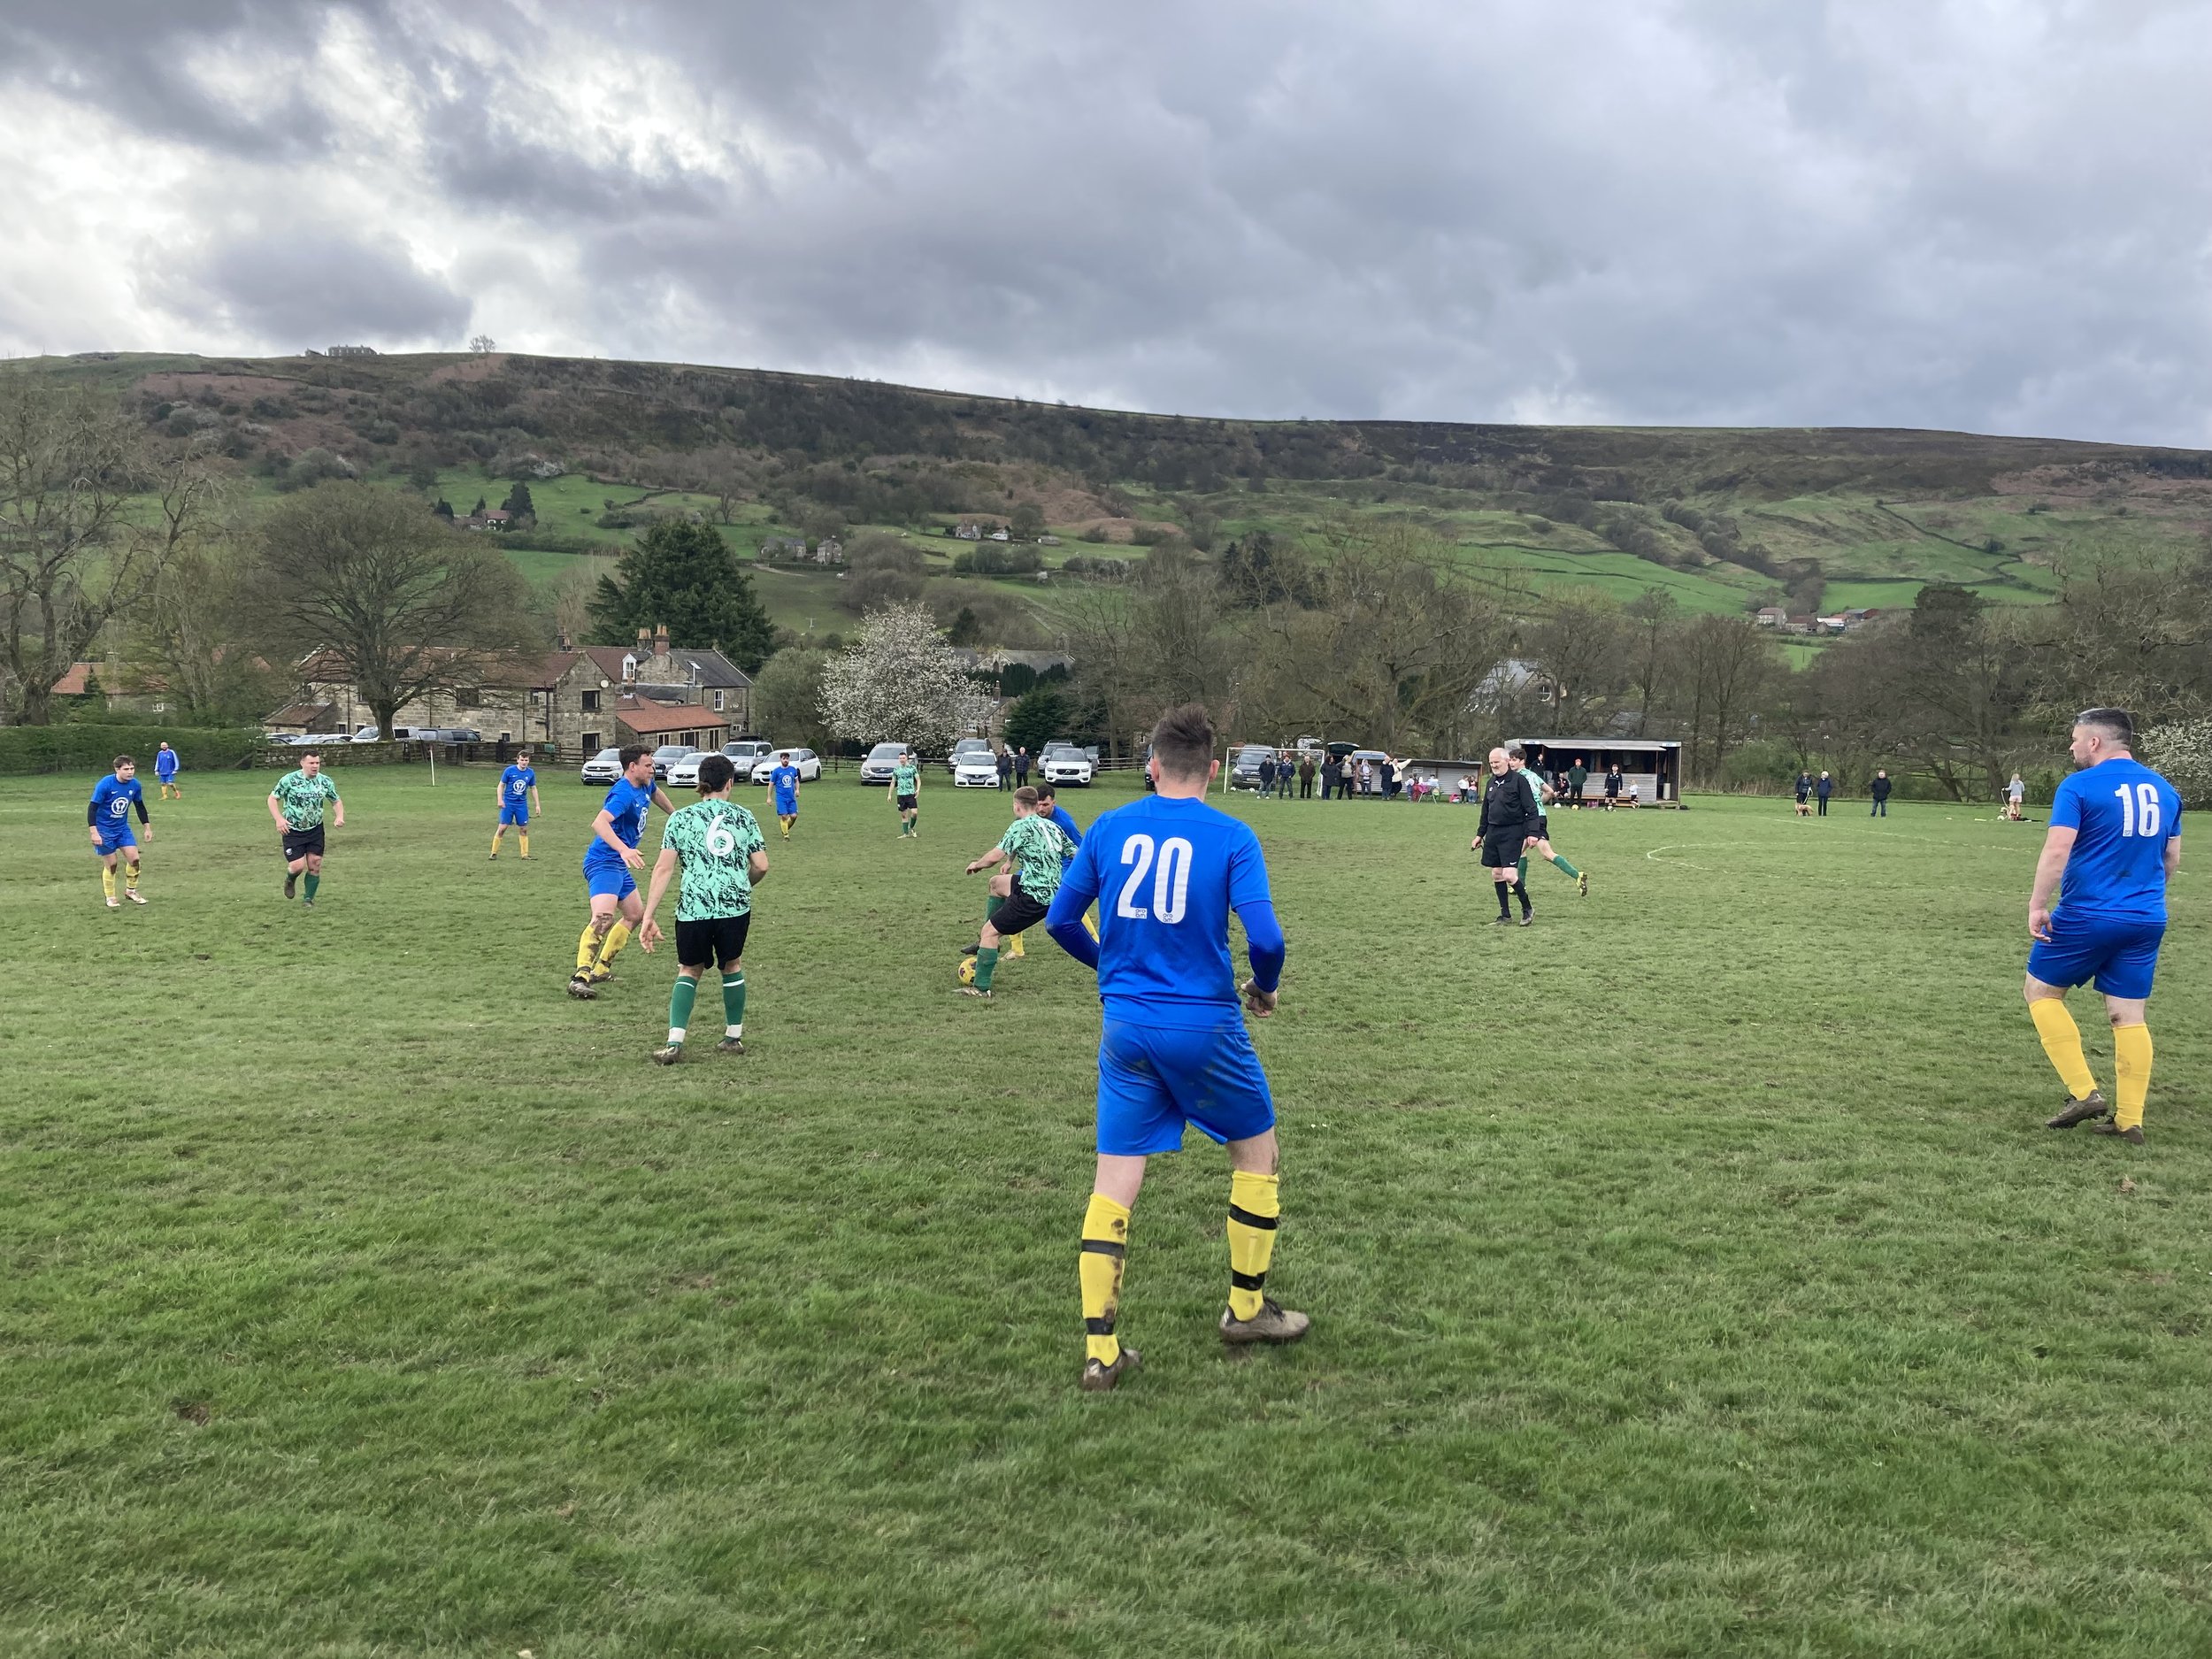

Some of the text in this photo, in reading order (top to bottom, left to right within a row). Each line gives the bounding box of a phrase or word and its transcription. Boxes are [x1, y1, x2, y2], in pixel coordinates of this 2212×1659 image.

[706, 813, 734, 856] 6
[2115, 783, 2160, 837] 16
[1118, 833, 1193, 924] 20
